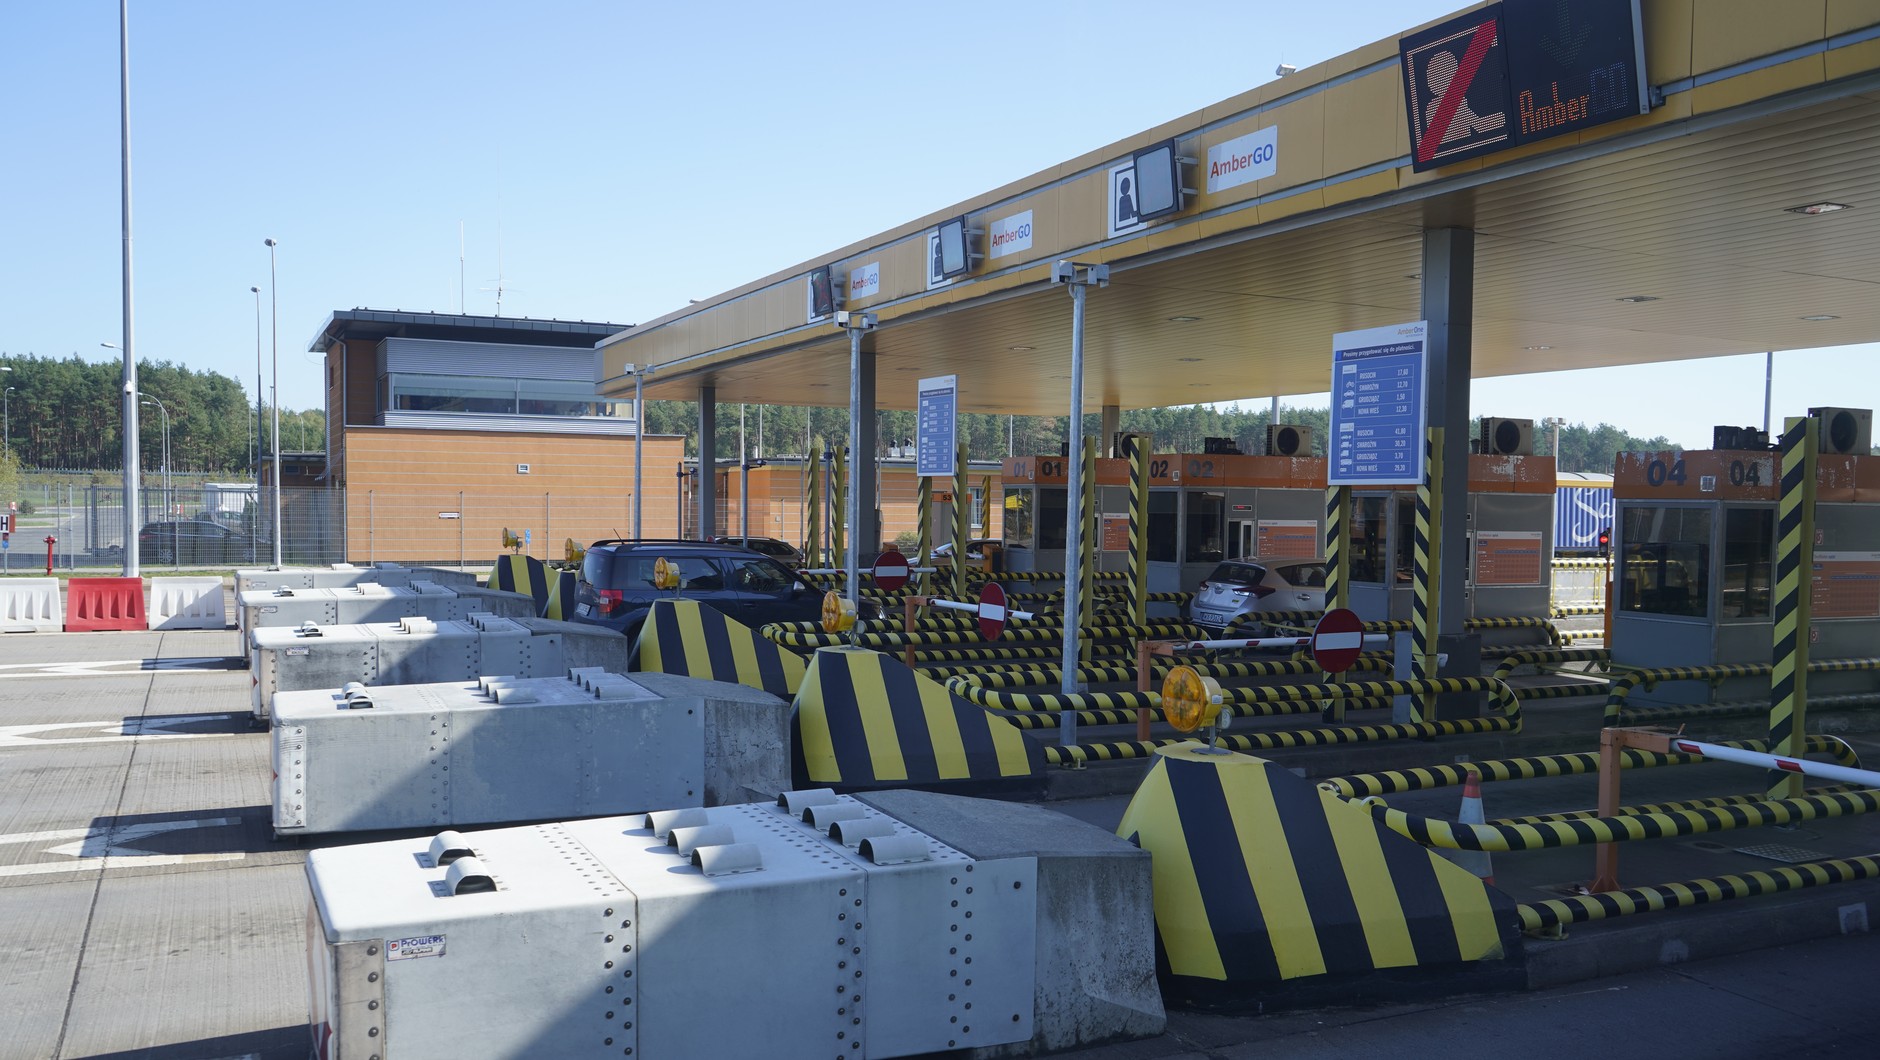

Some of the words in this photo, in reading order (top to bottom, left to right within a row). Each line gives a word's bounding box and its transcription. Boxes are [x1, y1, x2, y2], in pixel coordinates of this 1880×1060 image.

[1210, 144, 1273, 179] AmberGO
[992, 224, 1031, 248] AmberGO
[851, 272, 878, 291] AmberGO
[1014, 461, 1026, 477] 01
[1042, 461, 1061, 477] 01
[1150, 460, 1168, 478] 02
[1188, 460, 1214, 478] 02
[1647, 459, 1688, 487] 04
[1729, 459, 1760, 487] 04
[1, 516, 8, 530] H
